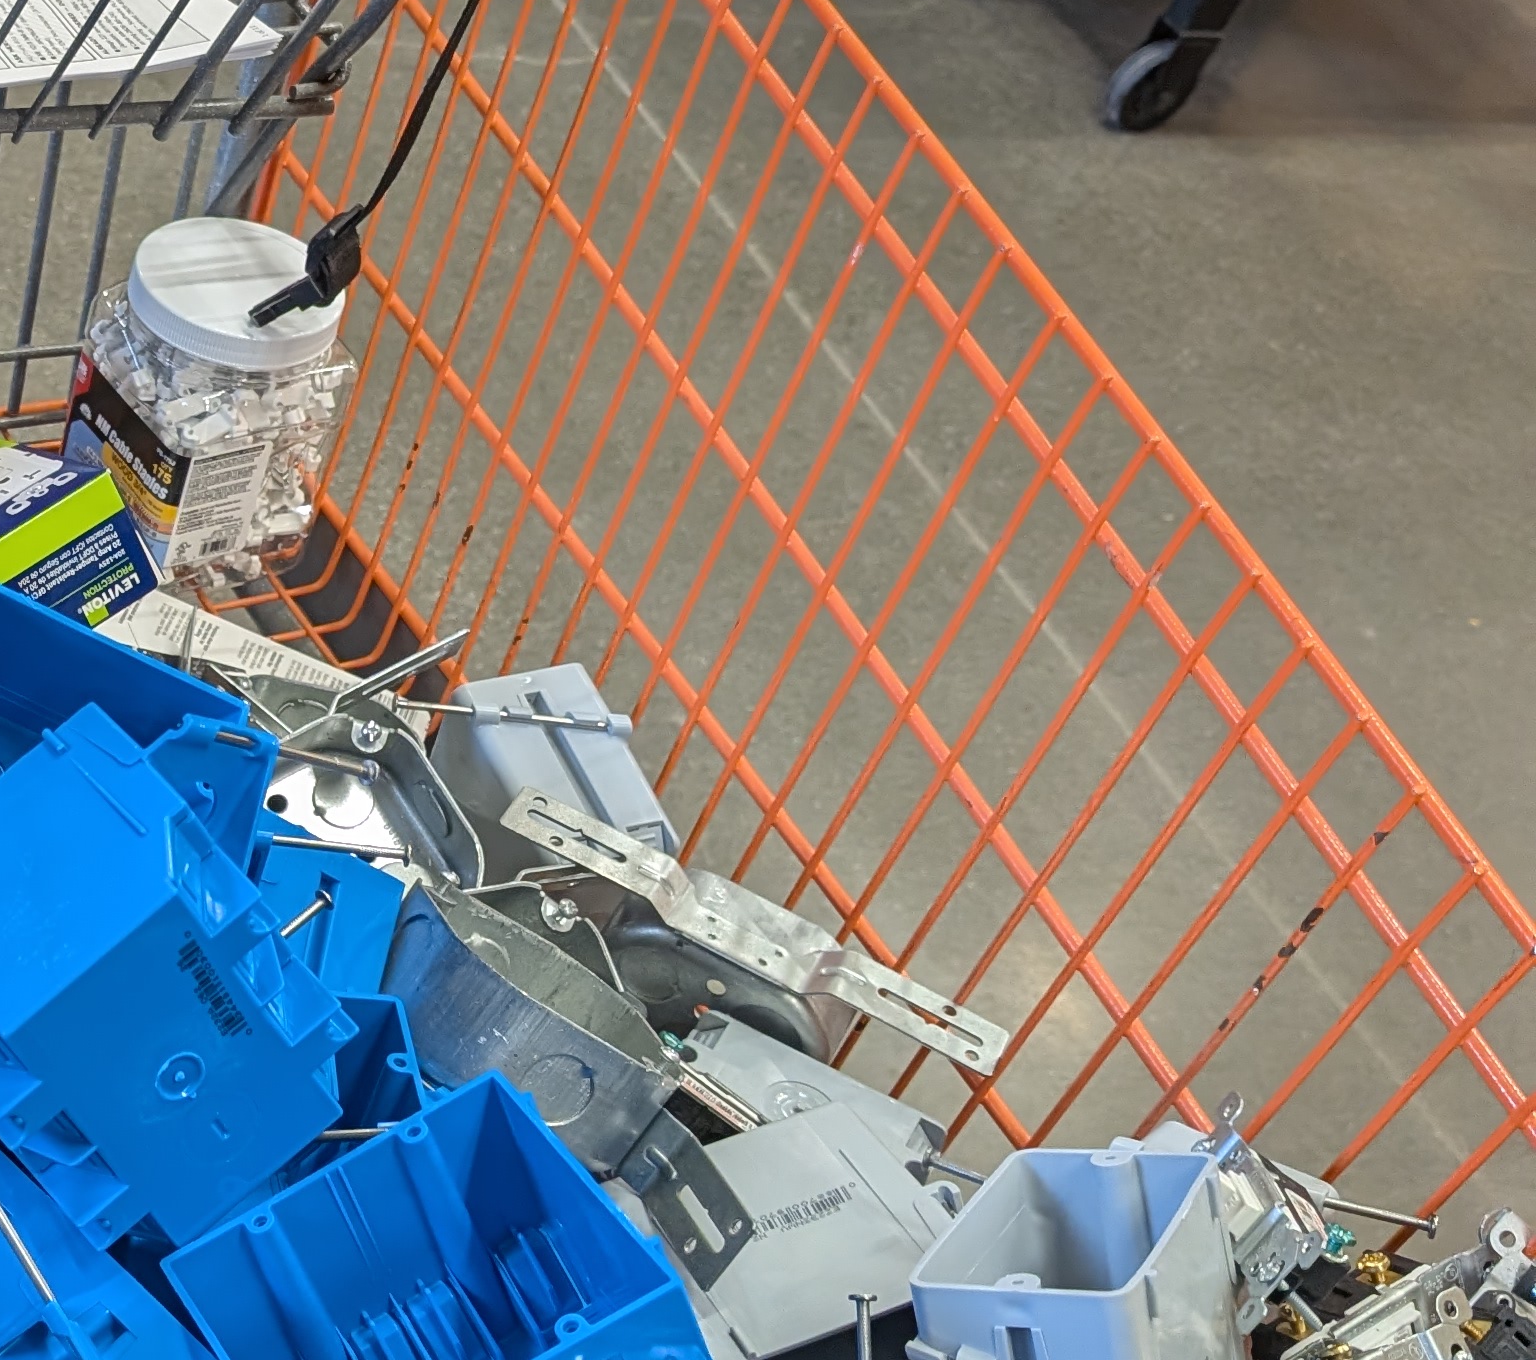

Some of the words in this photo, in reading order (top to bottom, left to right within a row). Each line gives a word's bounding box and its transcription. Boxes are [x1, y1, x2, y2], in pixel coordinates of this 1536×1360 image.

[93, 413, 112, 434] NM
[106, 430, 137, 464] Cable
[130, 457, 170, 501] Staples
[149, 461, 174, 486] 175
[85, 522, 114, 544] Contactos
[98, 530, 117, 546] Prises
[96, 543, 112, 557] Amp
[111, 538, 121, 549] 20
[59, 549, 71, 560] con
[36, 556, 59, 575] Seguro
[45, 552, 97, 590] Tamper-Resistant
[16, 575, 29, 586] 20A
[28, 569, 37, 579] de
[36, 575, 46, 585] de
[82, 562, 134, 598] PROTECTION
